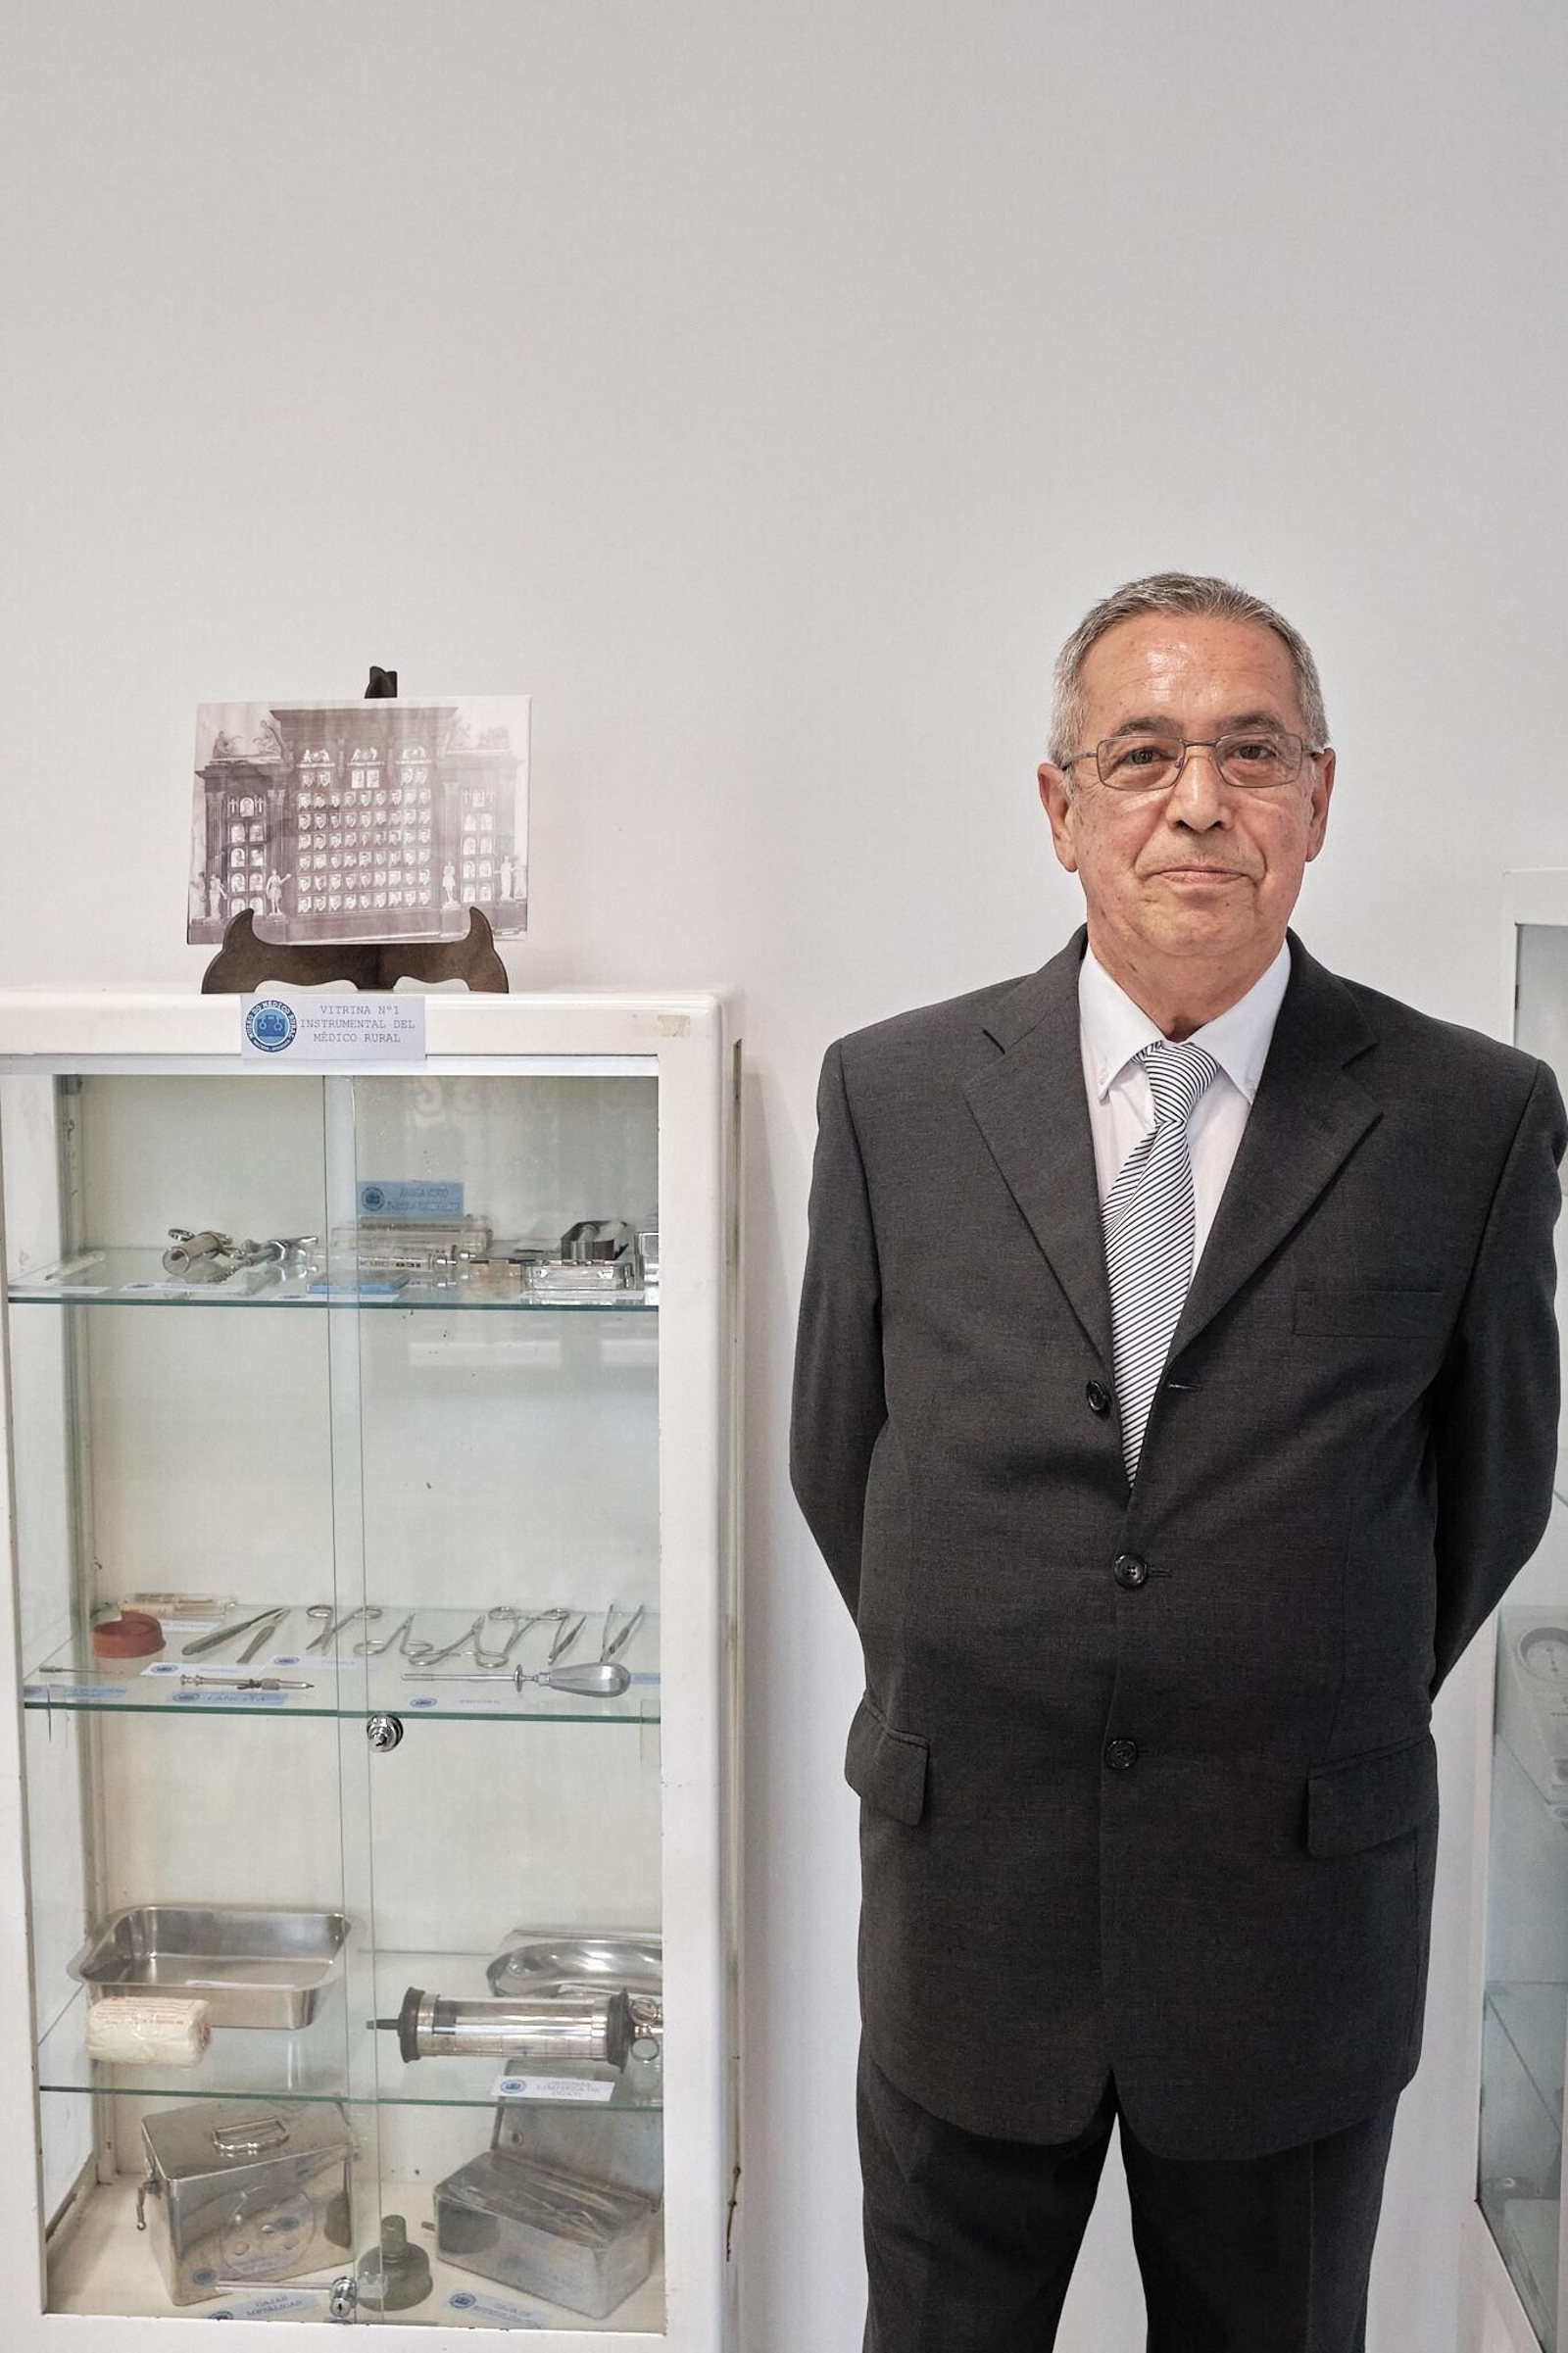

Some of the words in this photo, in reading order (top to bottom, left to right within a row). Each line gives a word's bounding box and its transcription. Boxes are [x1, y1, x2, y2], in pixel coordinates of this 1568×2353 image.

[319, 1005, 371, 1015] VITRINA
[300, 1019, 387, 1029] INSTRUMENTAL
[393, 1019, 416, 1029] DEL
[313, 1031, 358, 1043] MÉDICO
[364, 1033, 402, 1043] RURAL
